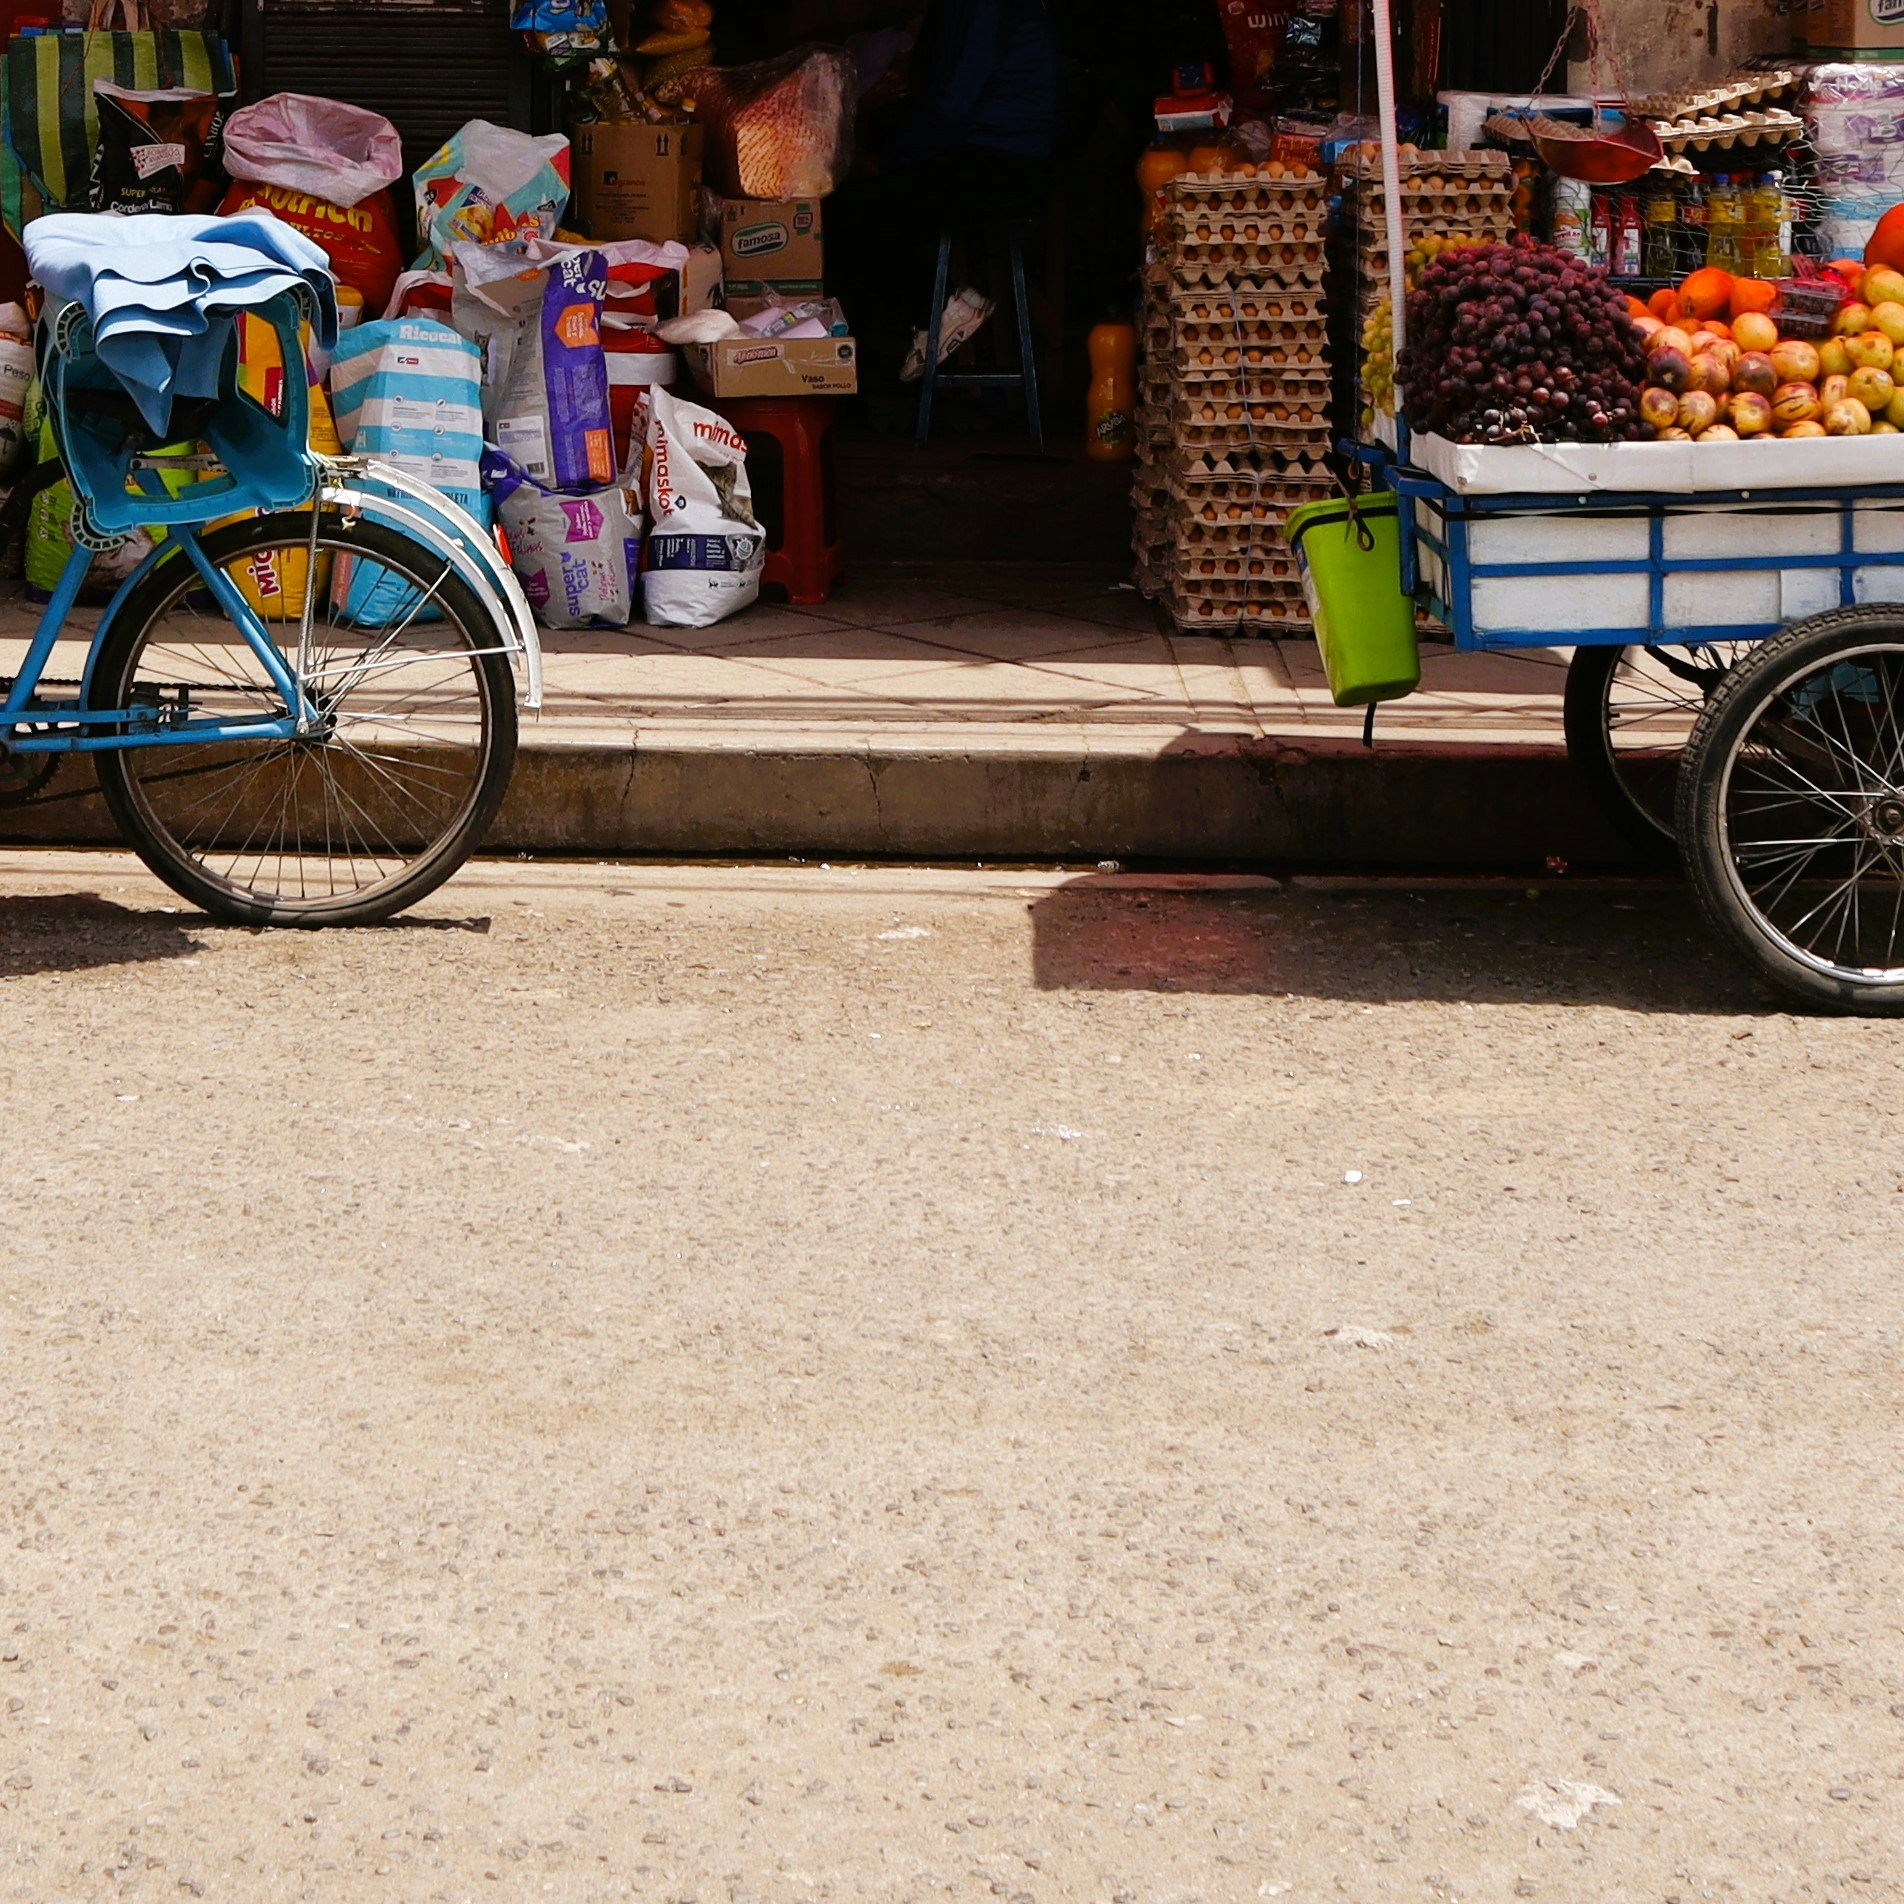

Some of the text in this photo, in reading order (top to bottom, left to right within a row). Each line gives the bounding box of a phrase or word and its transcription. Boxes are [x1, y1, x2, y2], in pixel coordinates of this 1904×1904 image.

[738, 231, 781, 249] famosa
[561, 260, 576, 287] cat
[4, 364, 30, 381] Peso
[801, 374, 825, 383] Vaso
[654, 420, 675, 516] mimaskot
[572, 559, 589, 590] cat
[562, 567, 580, 617] super
